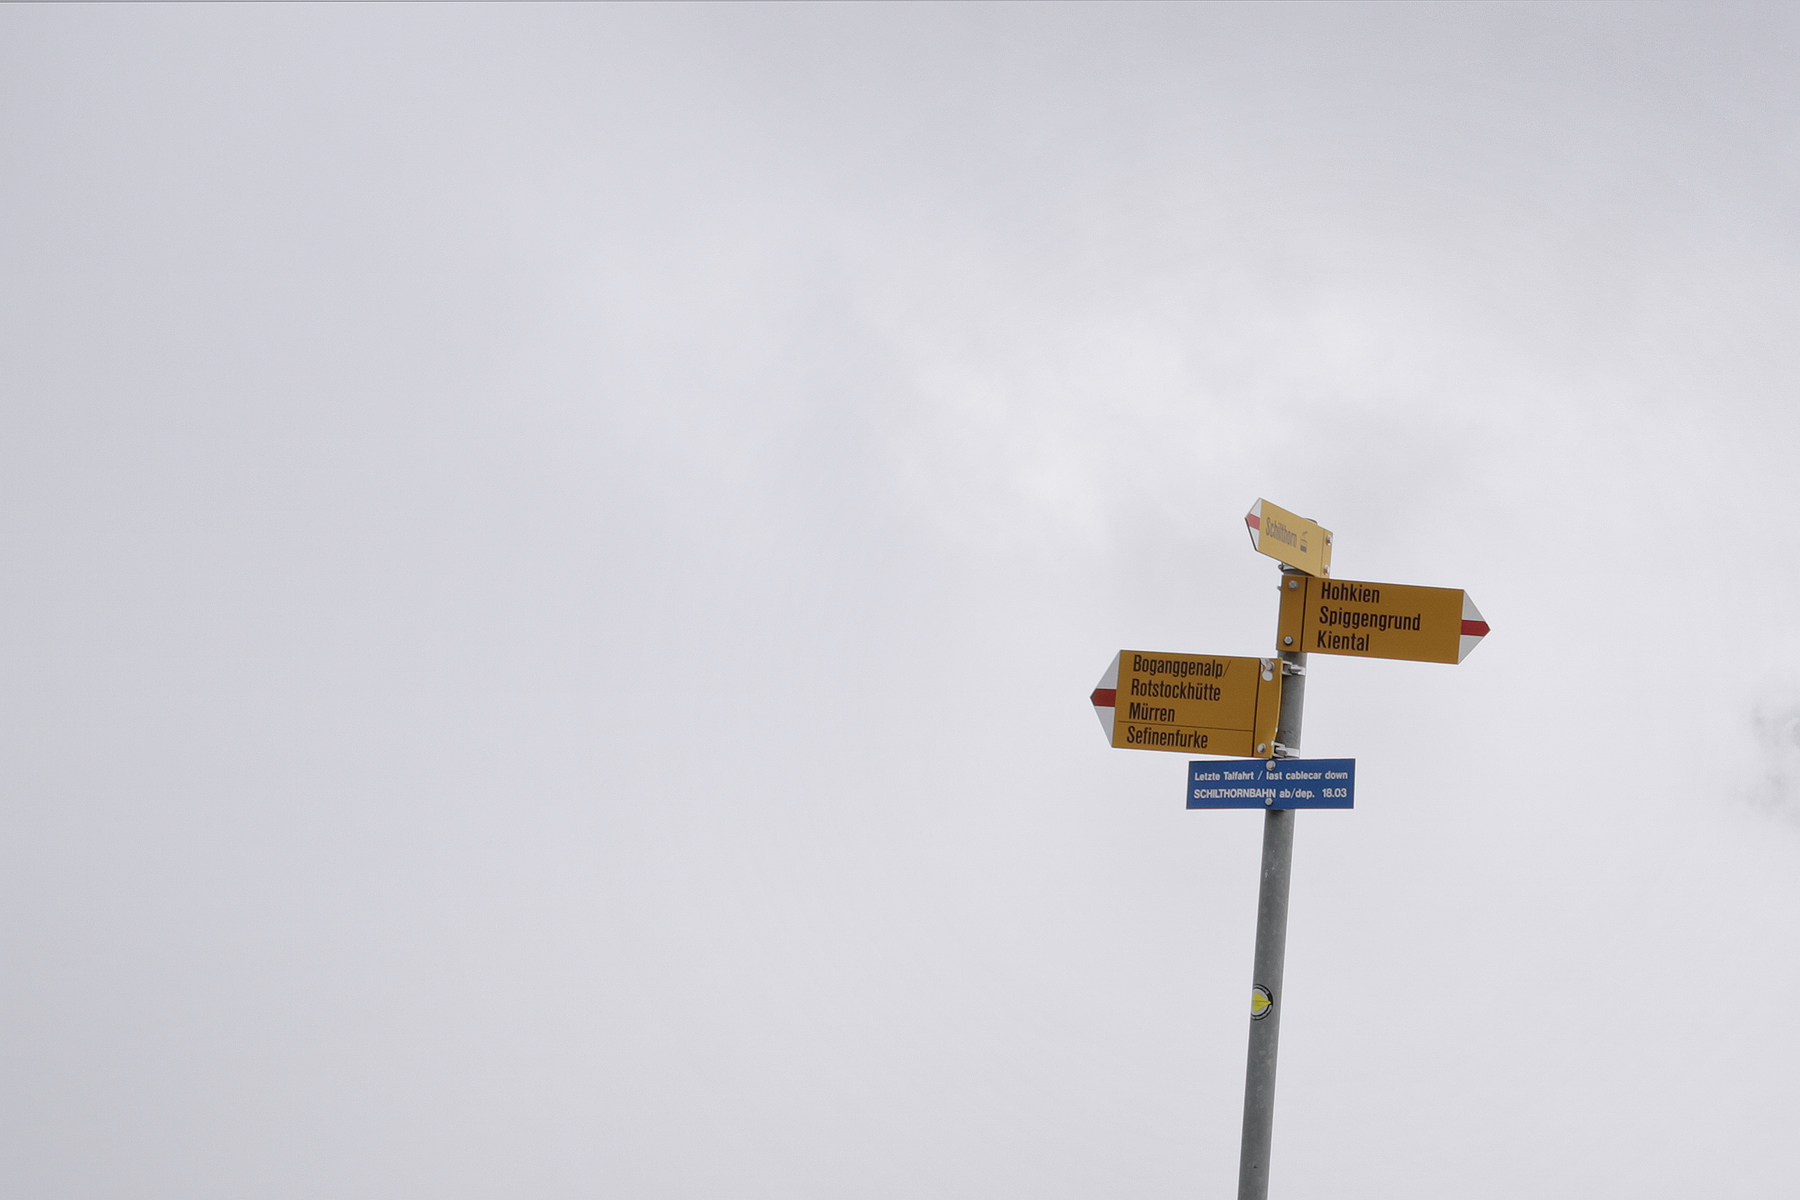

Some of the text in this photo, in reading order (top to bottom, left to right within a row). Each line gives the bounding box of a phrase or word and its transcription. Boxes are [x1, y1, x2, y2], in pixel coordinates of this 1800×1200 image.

[1321, 581, 1380, 604] Hohkien
[1319, 605, 1421, 632] Spiggengrund
[1317, 630, 1370, 651] Kiental
[1133, 654, 1231, 679] Boganggenalp/
[1130, 678, 1221, 701] Rotstockhütte
[1128, 702, 1176, 722] Mürren
[1126, 725, 1208, 749] Sefinenfurke
[1194, 772, 1221, 781] Letzte
[1223, 771, 1254, 781] Talfahrt
[1266, 771, 1283, 780] last
[1285, 770, 1323, 780] cablecar
[1324, 770, 1348, 780] down
[1193, 787, 1348, 800] SCHILTHORNBAHN ab/dep. 18.03
